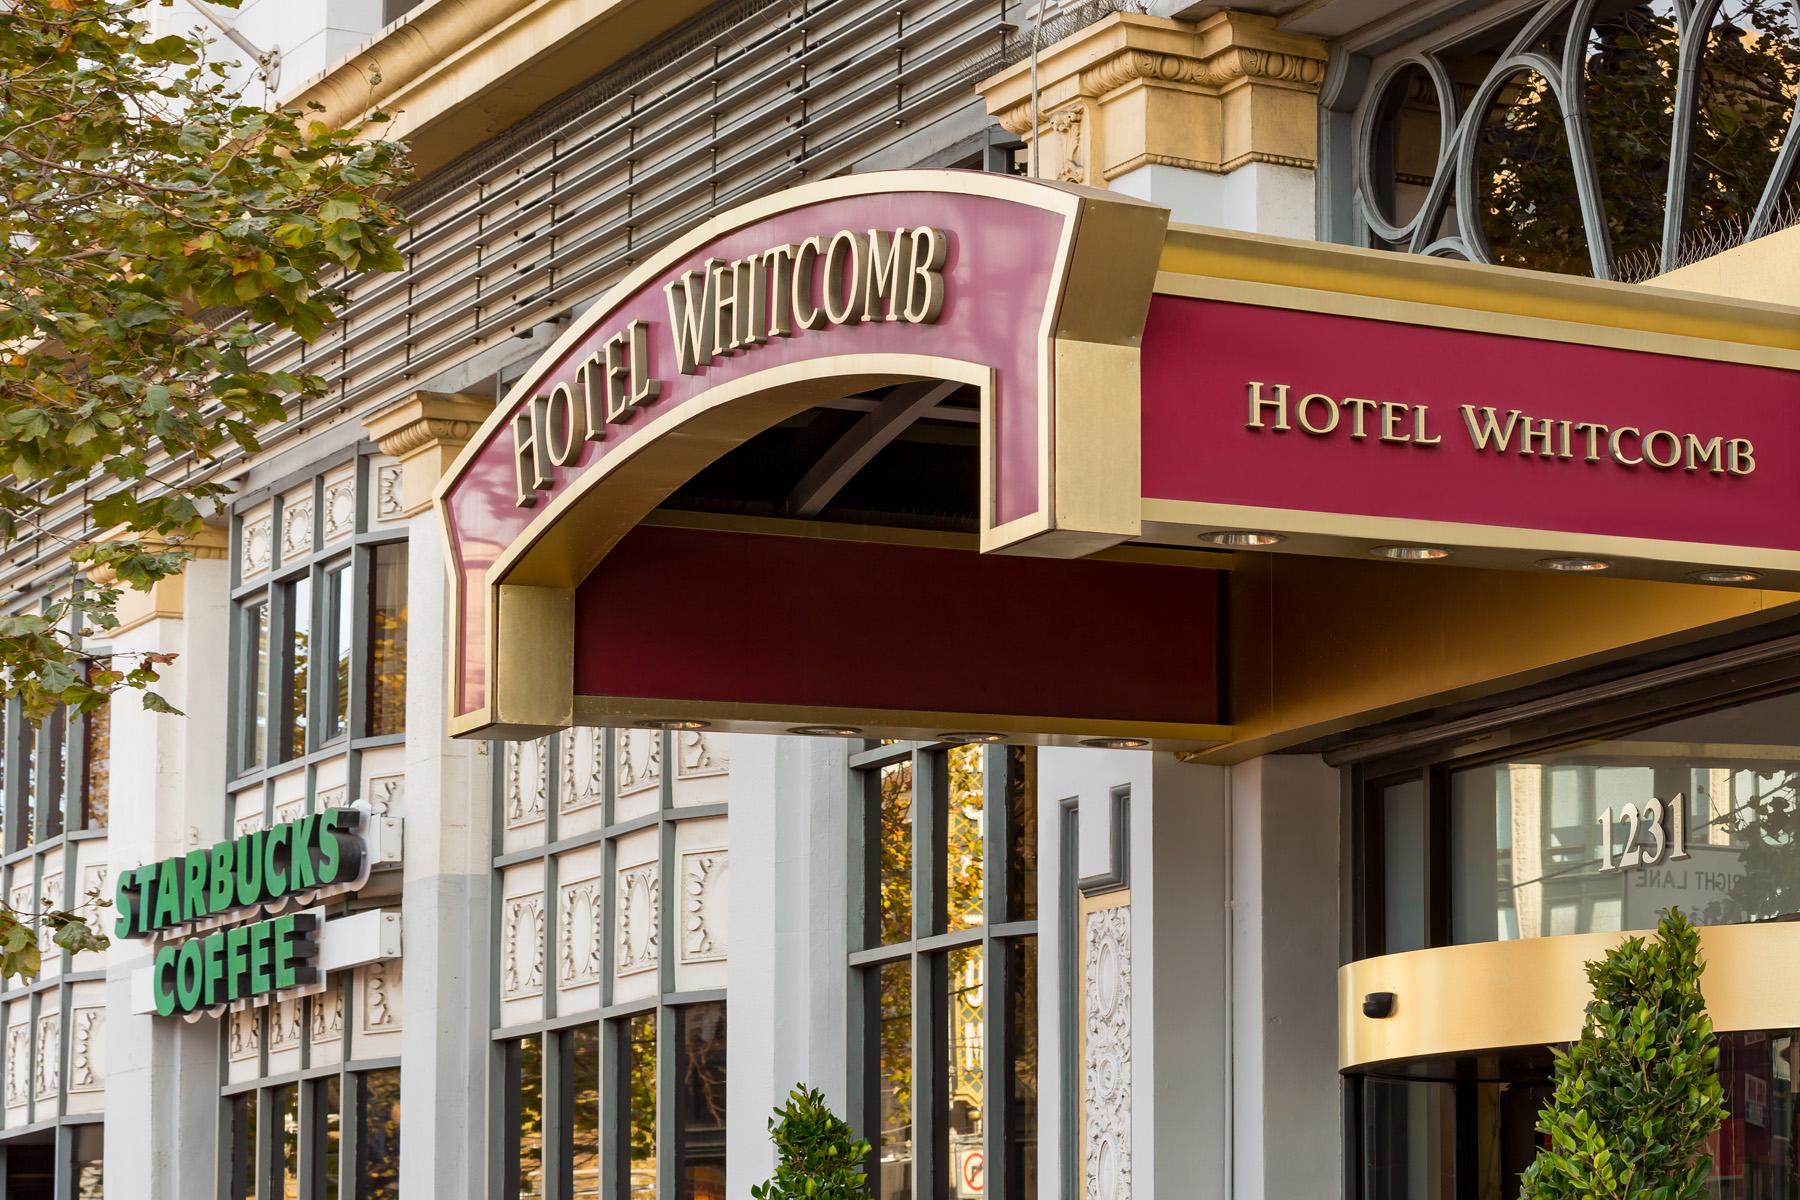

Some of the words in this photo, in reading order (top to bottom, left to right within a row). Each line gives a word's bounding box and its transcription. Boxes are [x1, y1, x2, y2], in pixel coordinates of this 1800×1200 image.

[510, 318, 662, 508] HOTEL
[663, 225, 947, 375] WHITCOMB
[1245, 381, 1442, 446] HOTEL
[1459, 403, 1757, 476] WHITCOMB
[114, 807, 352, 940] STARBUCKS
[1597, 792, 1691, 873] 1231
[153, 914, 309, 1017] COFFEE
